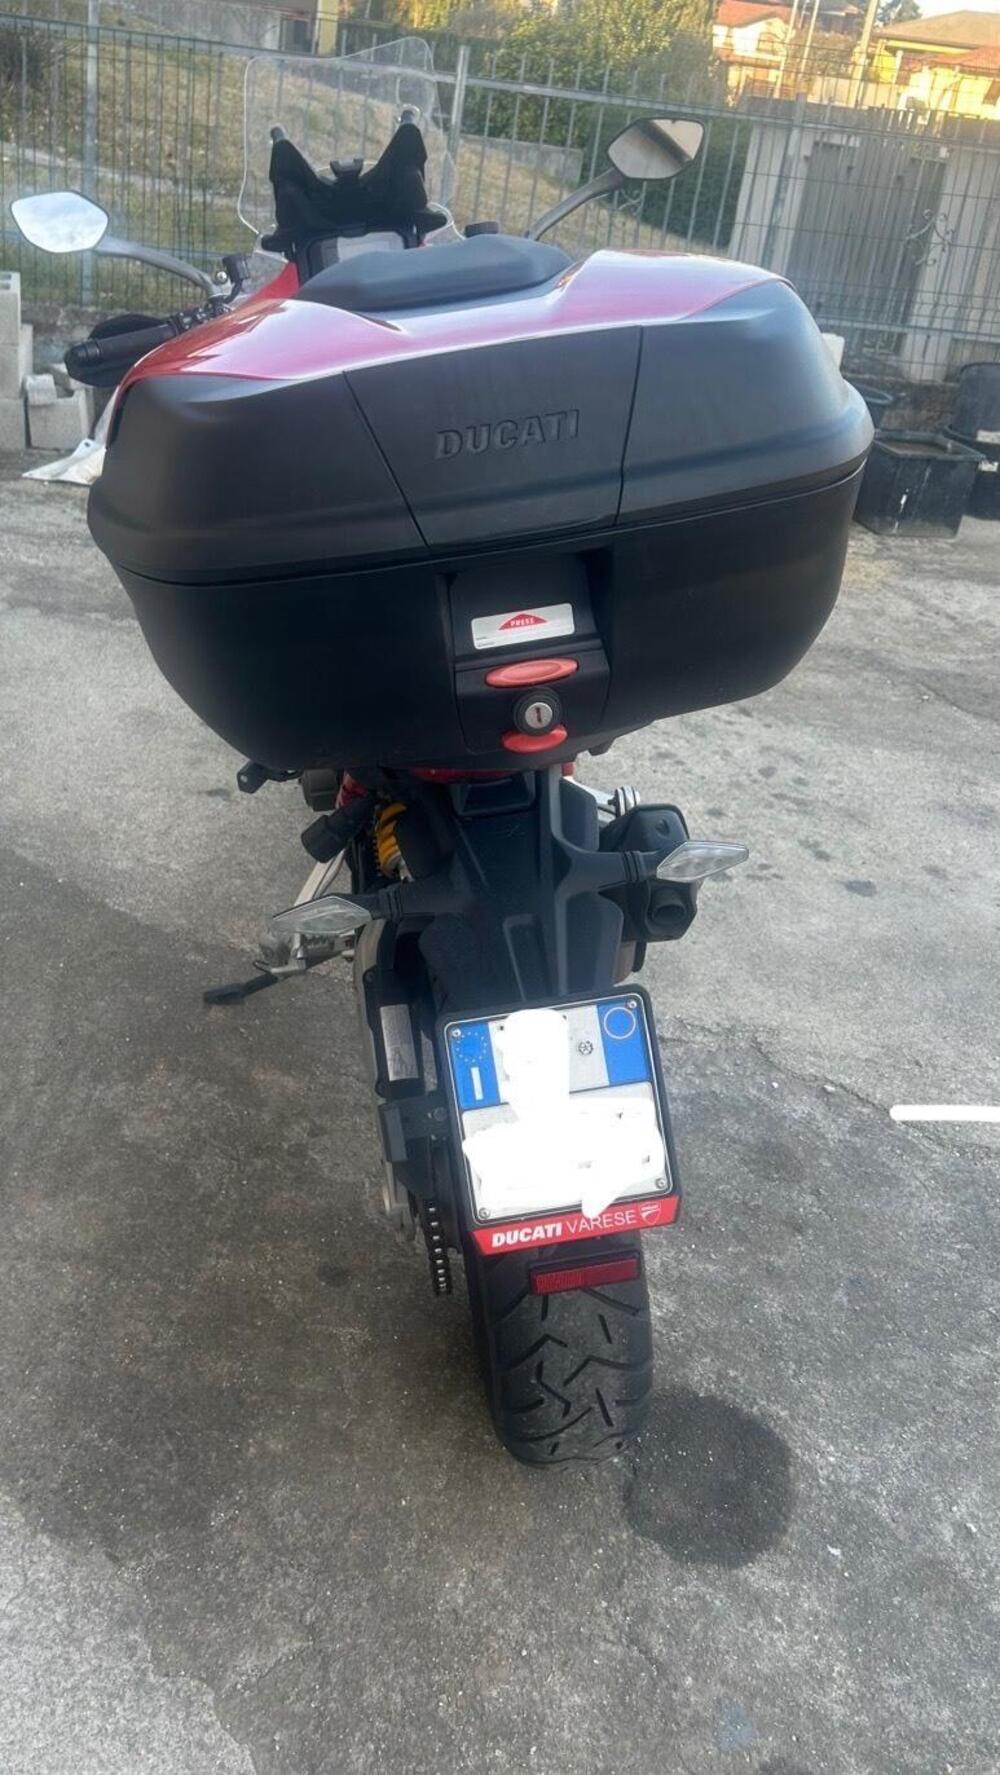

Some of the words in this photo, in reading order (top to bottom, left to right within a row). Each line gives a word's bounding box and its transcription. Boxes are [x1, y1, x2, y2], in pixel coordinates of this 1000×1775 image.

[435, 409, 579, 459] DUCATI
[510, 617, 534, 627] PRESS
[492, 1222, 562, 1247] DUCATI
[566, 1210, 636, 1233] VARESE
